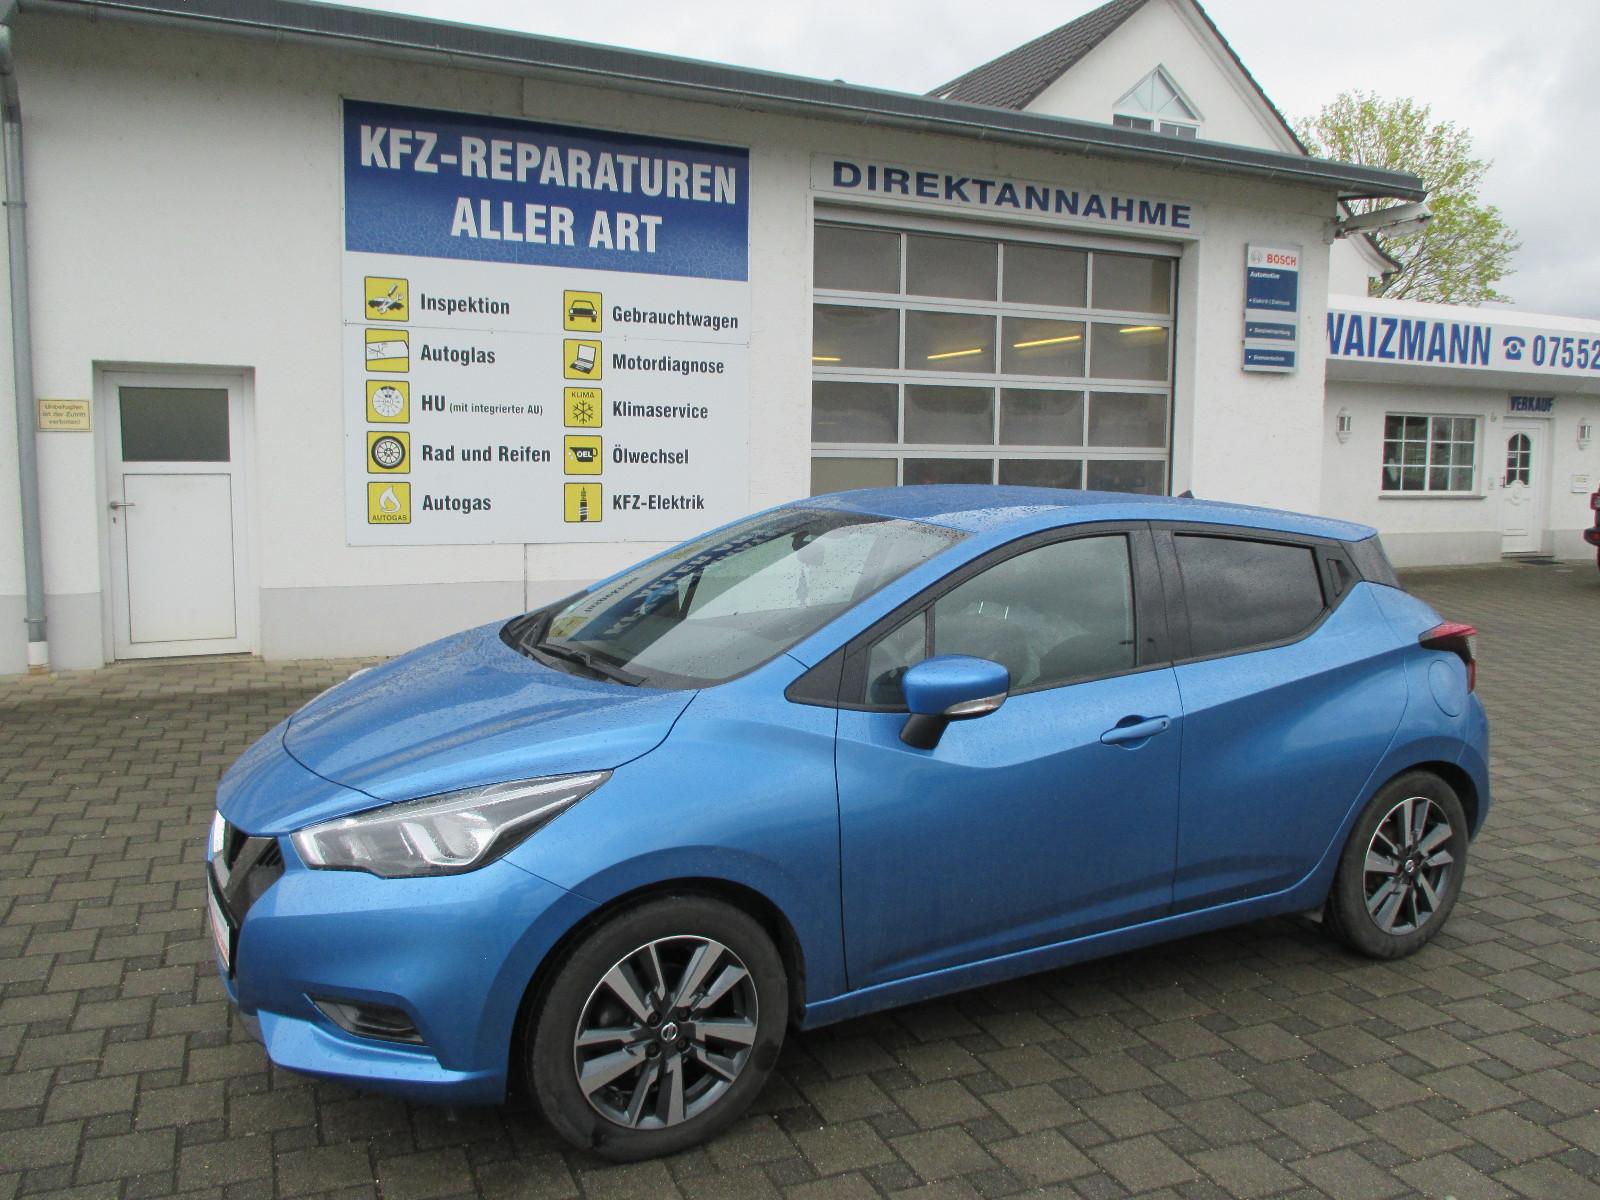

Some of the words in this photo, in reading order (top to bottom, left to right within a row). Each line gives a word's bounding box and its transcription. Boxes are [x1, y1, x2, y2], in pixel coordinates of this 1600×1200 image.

[360, 124, 736, 205] KFZ-REPARATUREN
[832, 160, 1191, 229] DIREKTANNAHME
[451, 197, 575, 247] ALLER
[588, 210, 663, 254] ART
[1266, 253, 1297, 267] BOSCH
[420, 293, 510, 315] Inspektion
[612, 306, 739, 331] Gebrauchtwagen
[420, 344, 496, 367] Autoglas
[1532, 334, 1600, 370] 07552
[612, 353, 725, 376] Motordiagnose
[421, 394, 446, 412] HU
[449, 402, 468, 414] (mit
[471, 403, 525, 415] integrierter
[527, 405, 543, 416] AU)
[571, 391, 595, 399] KLIMA
[1510, 396, 1554, 412] VERKAUF
[612, 401, 709, 419] Klimaservice
[422, 444, 455, 462] Rad
[461, 445, 492, 462] und
[498, 445, 551, 463] Reifen
[576, 450, 593, 458] OEL
[612, 444, 689, 464] Ölwechsel
[422, 494, 492, 514] Autogas
[612, 494, 705, 511] KFZ-Elektrik
